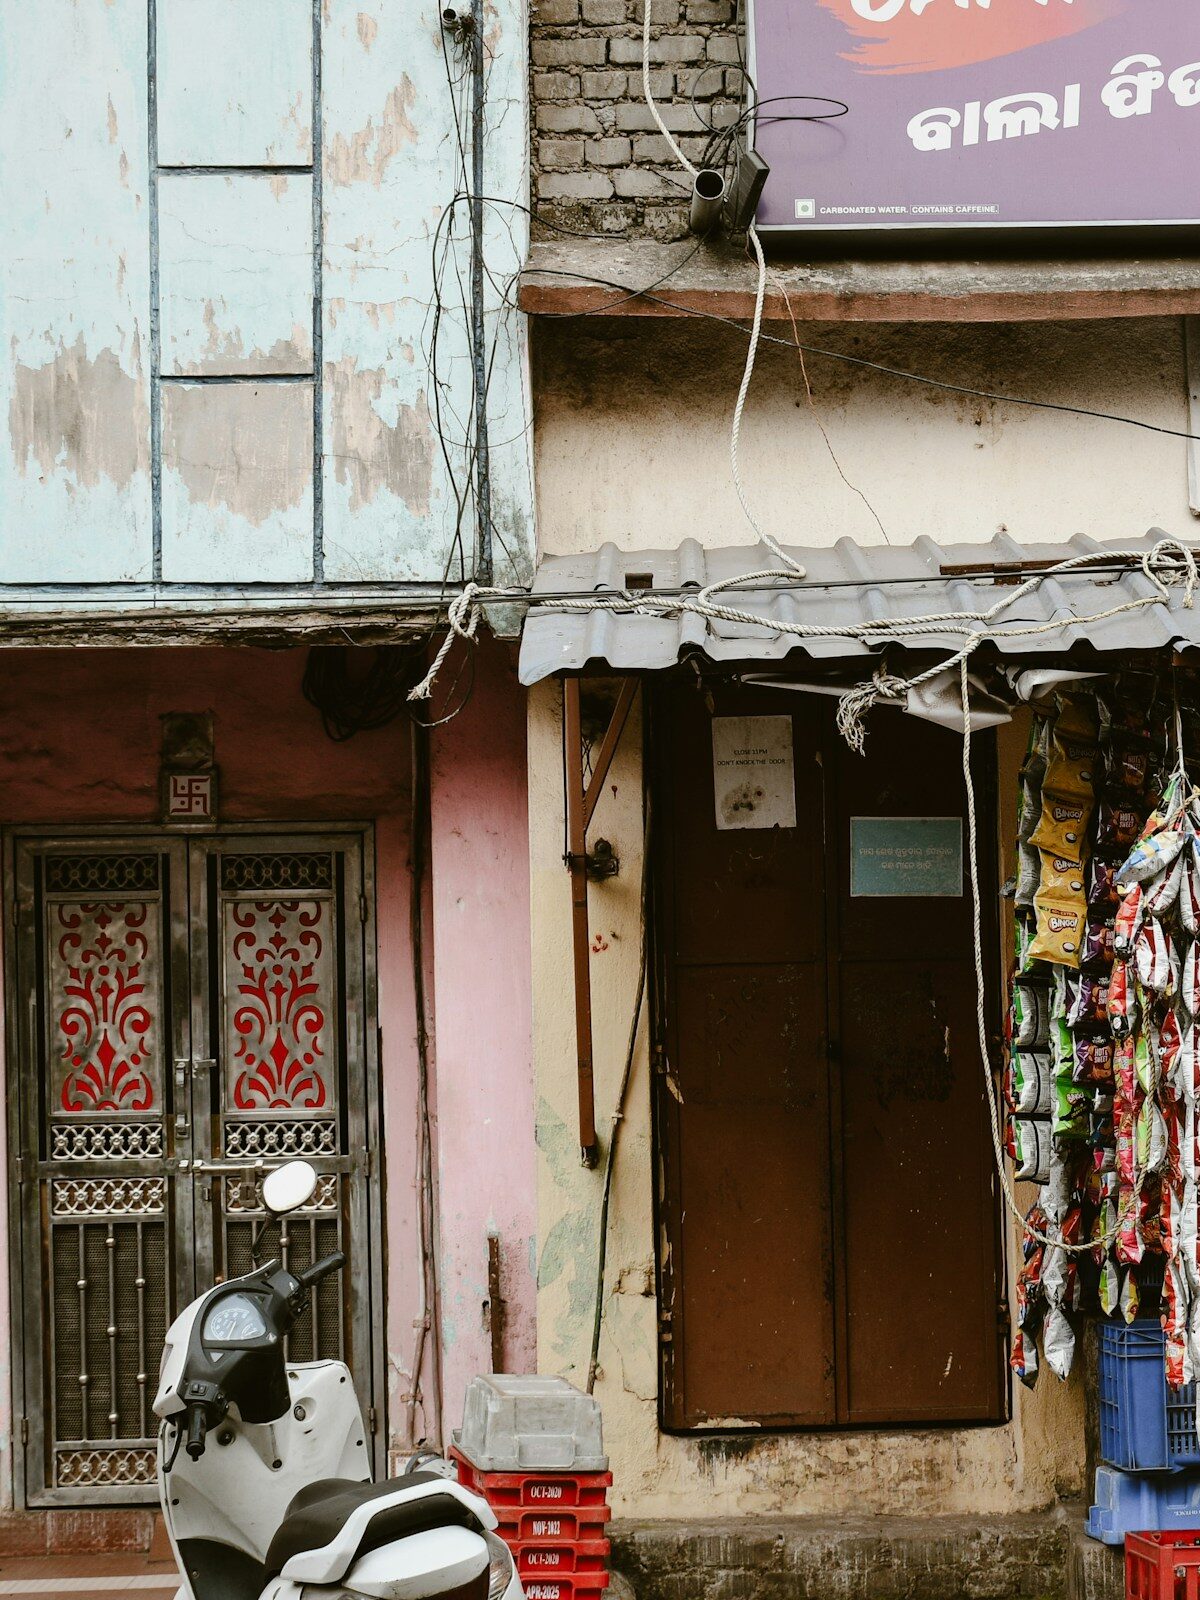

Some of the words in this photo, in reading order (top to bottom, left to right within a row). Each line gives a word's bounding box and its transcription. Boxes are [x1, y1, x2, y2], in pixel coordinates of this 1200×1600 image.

[819, 205, 876, 214] CARBONATED
[877, 205, 909, 214] WATER.
[911, 205, 954, 214] CONTAINS
[955, 205, 998, 214] CAFFEINE.
[1050, 917, 1078, 932] BINGO!
[530, 1485, 562, 1499] OCT-2020
